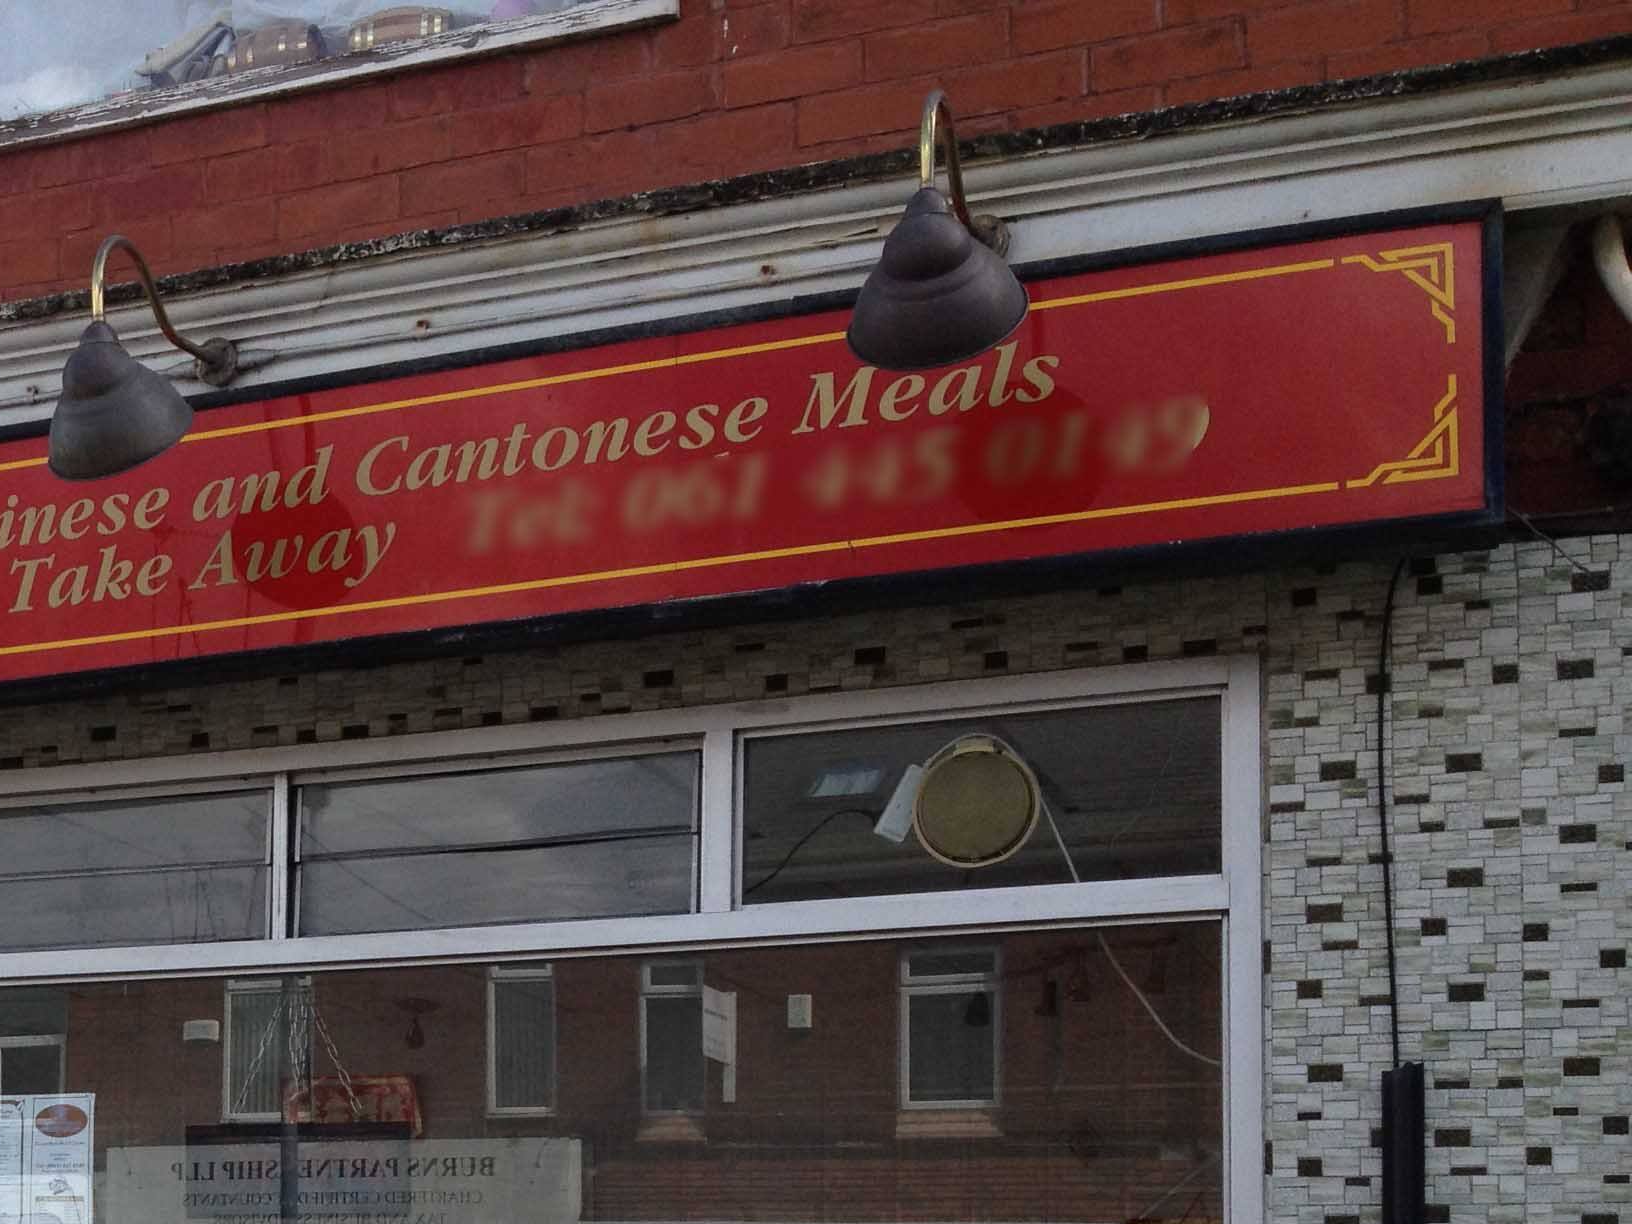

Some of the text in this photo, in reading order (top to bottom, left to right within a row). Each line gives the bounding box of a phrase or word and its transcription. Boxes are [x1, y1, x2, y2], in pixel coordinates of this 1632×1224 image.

[192, 445, 335, 523] and
[355, 396, 769, 497] Cantonese
[791, 342, 1063, 435] Meals
[9, 546, 174, 615] Take
[188, 519, 397, 590] Away
